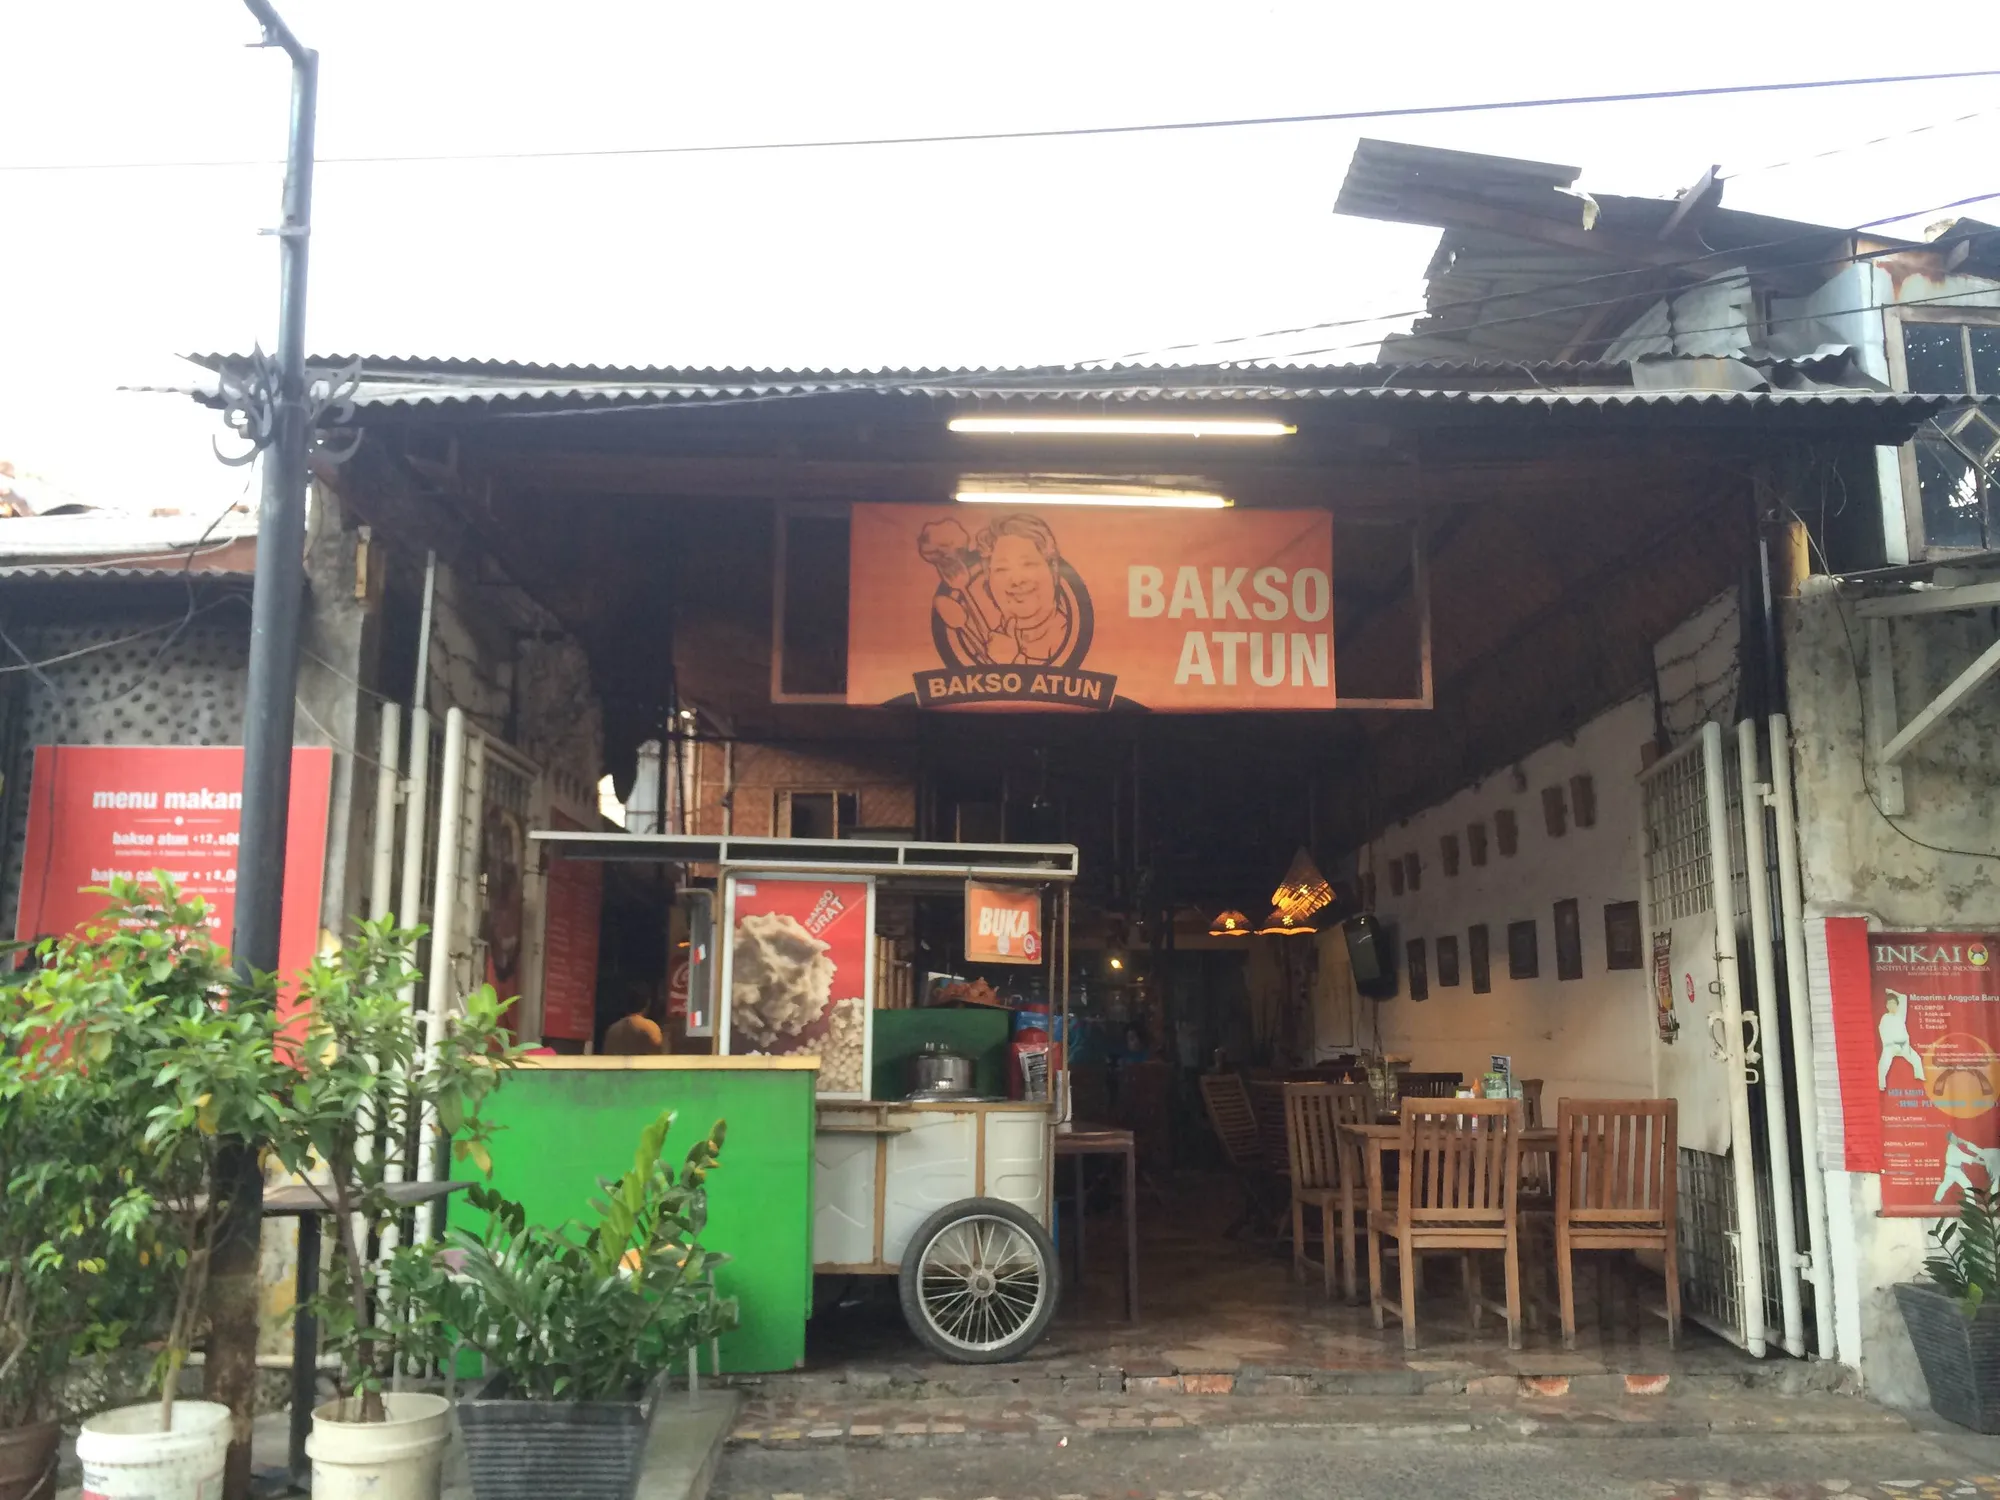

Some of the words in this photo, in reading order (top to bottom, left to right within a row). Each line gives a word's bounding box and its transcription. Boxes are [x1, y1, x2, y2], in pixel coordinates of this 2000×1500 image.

[1128, 565, 1330, 622] BAKSO
[1174, 630, 1329, 687] ATUN
[928, 673, 1022, 698] BAKSO
[1030, 674, 1101, 700] ATUN
[92, 790, 158, 810] menu
[112, 831, 154, 846] bakso
[804, 889, 834, 928] BAKSO
[810, 896, 844, 934] URAT
[979, 907, 1030, 938] BUKA
[1874, 945, 1962, 963] INKAI
[1947, 994, 1980, 1003] Anggota
